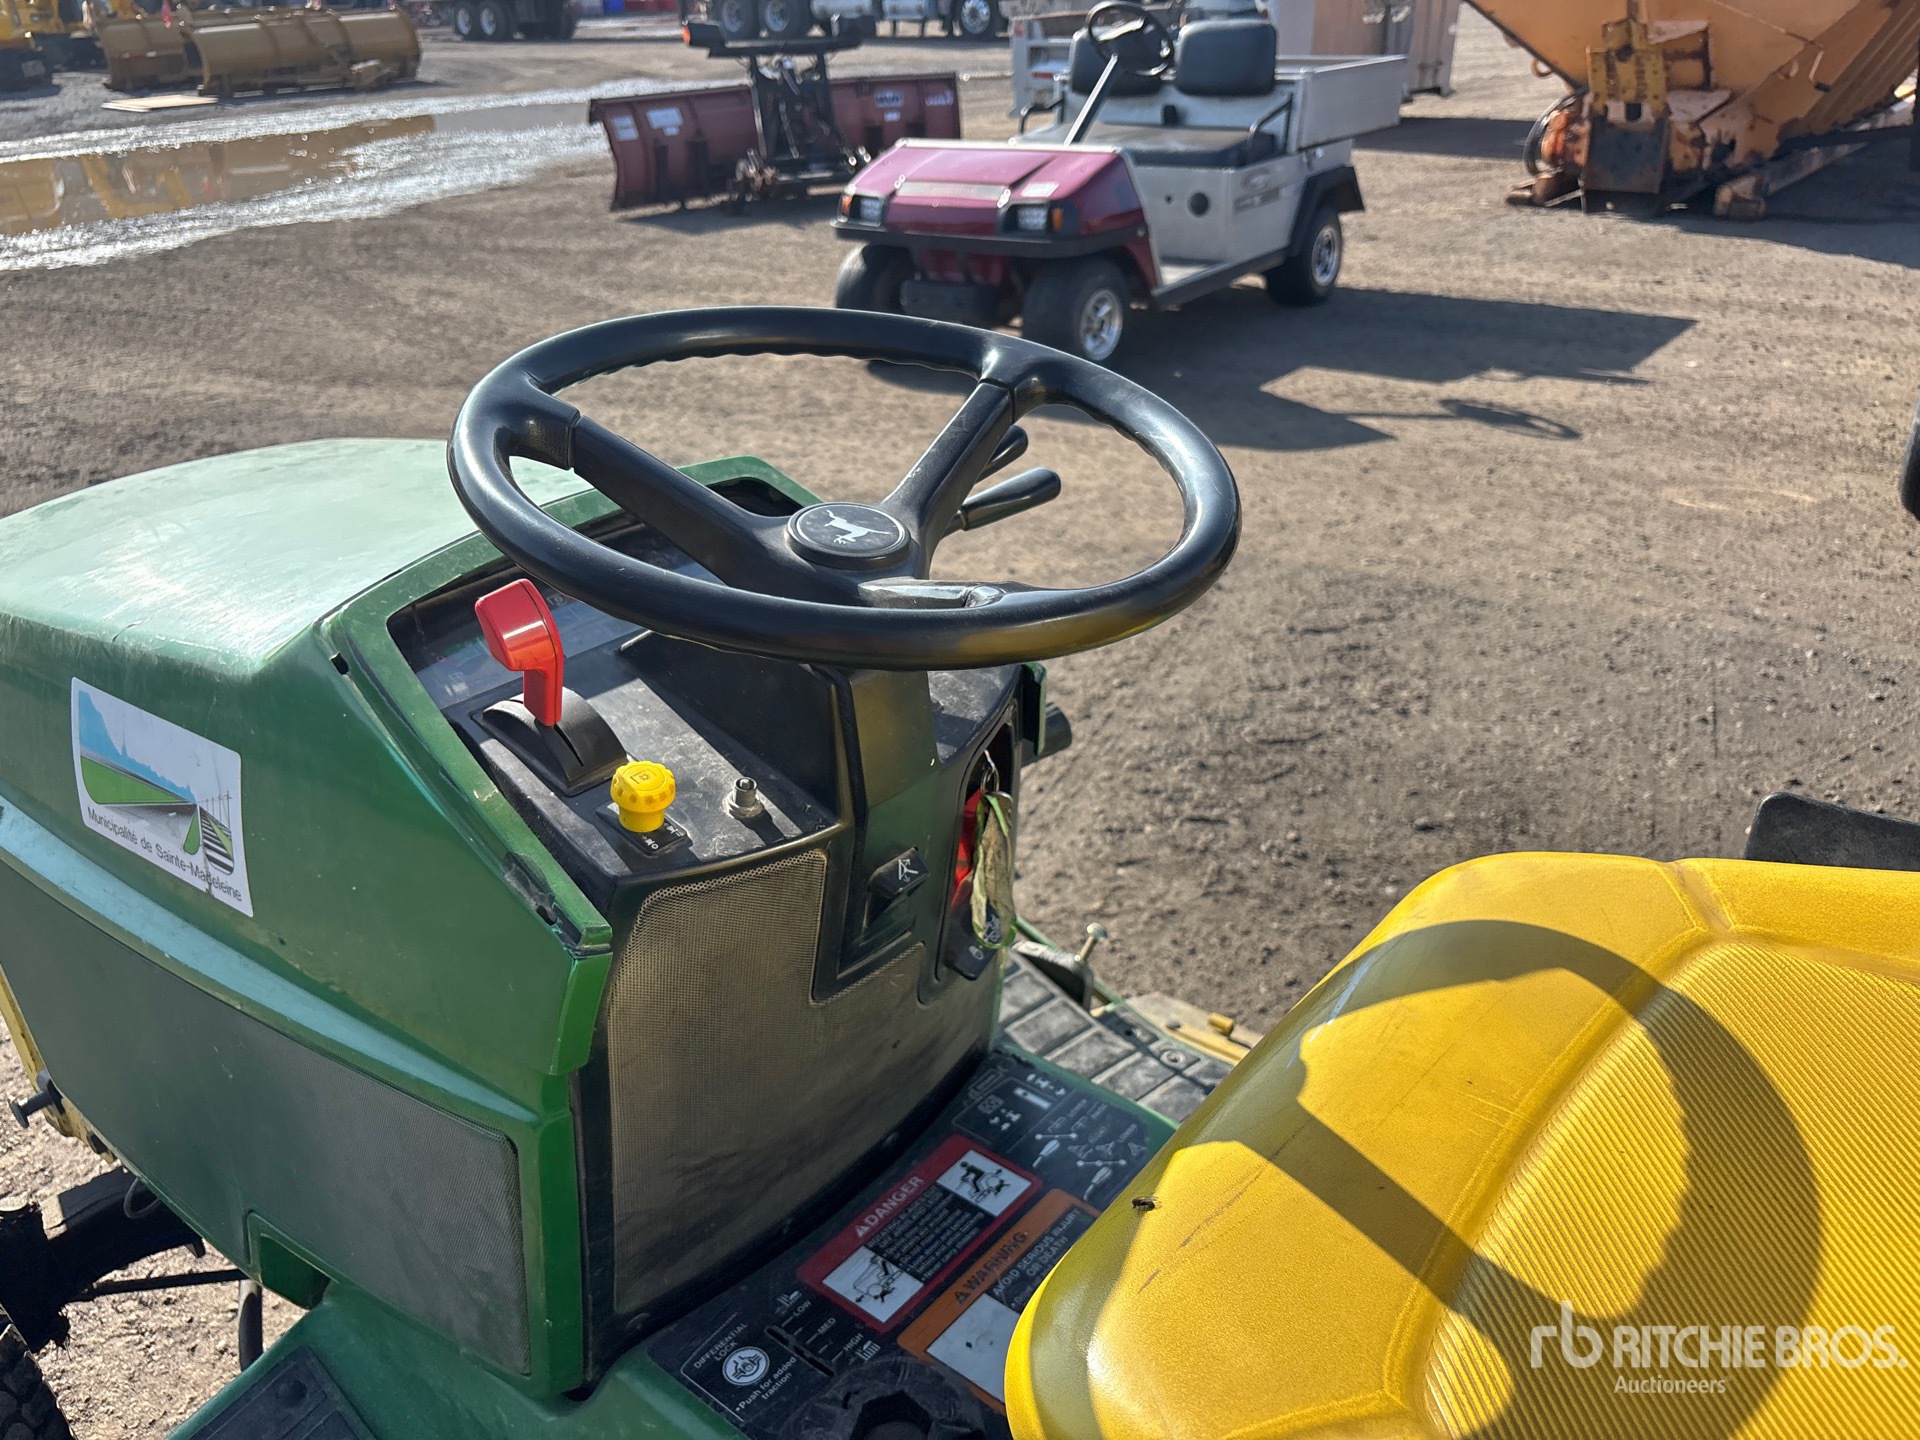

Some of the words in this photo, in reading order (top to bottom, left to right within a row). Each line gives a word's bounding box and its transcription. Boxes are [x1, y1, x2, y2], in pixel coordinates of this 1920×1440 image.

[87, 807, 138, 845] Municipalité
[140, 836, 153, 853] de
[155, 842, 242, 902] Sainte-Madeleine
[864, 1176, 924, 1227] DANGER
[963, 1231, 1027, 1290] WARNING
[992, 1268, 1020, 1297] AVOID
[1017, 1235, 1055, 1271] SERIOUS
[1051, 1207, 1080, 1238] INJURY
[1026, 1263, 1041, 1277] OR
[1038, 1236, 1069, 1264] DEATH
[793, 1300, 812, 1317] LOW
[817, 1317, 837, 1335] MED
[693, 1322, 749, 1369] DIFFERENTIAL
[714, 1340, 738, 1362] LOCK
[843, 1332, 864, 1352] HIGH
[738, 1389, 762, 1410] Push
[760, 1379, 774, 1392] for
[773, 1357, 798, 1379] added
[761, 1371, 793, 1401] traction
